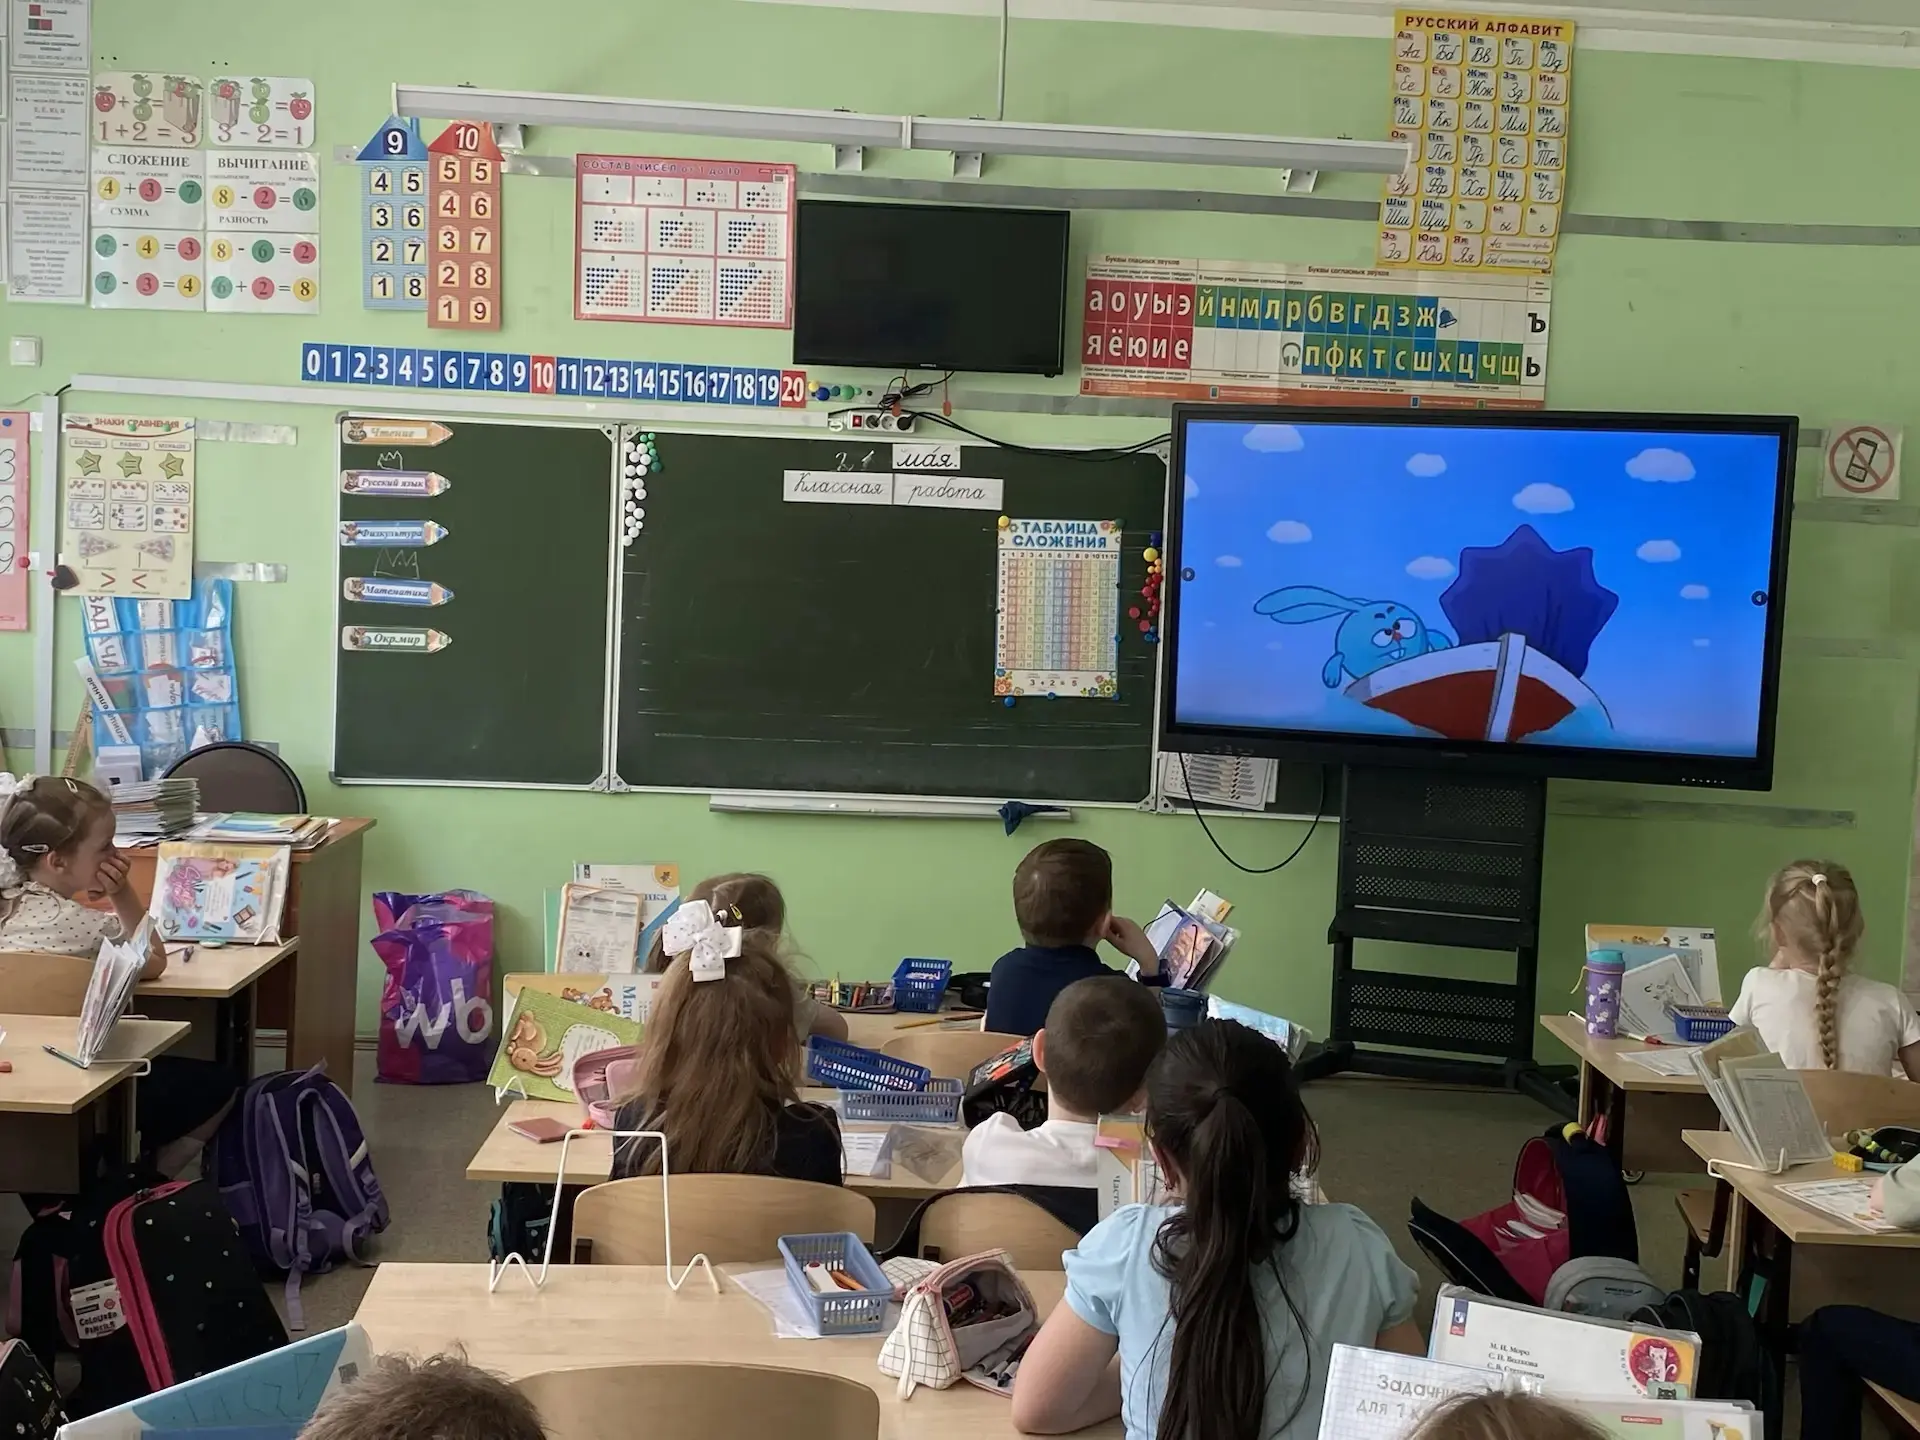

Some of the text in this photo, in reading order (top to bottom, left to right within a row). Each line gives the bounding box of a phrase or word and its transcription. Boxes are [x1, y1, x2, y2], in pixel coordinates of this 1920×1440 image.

[1406, 16, 1564, 37] РУССКИЙ АЛФАВИТ
[388, 131, 403, 154] 9
[456, 126, 479, 150] 10
[108, 154, 190, 168] СЛОЖЕНИЕ
[218, 157, 310, 171] ВЫЧИТАНИЕ
[583, 160, 631, 171] СОСТАВ
[636, 162, 677, 172] ЧИСЕЛ
[444, 161, 488, 181] 5 5
[104, 180, 195, 198] 4 3 7
[375, 173, 419, 192] 4 5
[219, 189, 308, 206] 8 2 6
[442, 196, 487, 216] 4 6
[110, 207, 150, 217] СУММА
[219, 216, 269, 225] РАЗНОСТЬ
[376, 208, 420, 227] 3 6
[443, 231, 487, 250] 3 7
[376, 243, 421, 262] 2 7
[1105, 255, 1125, 264] Буквы
[442, 266, 487, 286] 2 8
[1308, 266, 1326, 276] Буквы
[378, 278, 421, 297] 1 8
[443, 301, 486, 320] 1 9
[1089, 290, 1192, 321] а о у ы э
[1198, 288, 1435, 331] й н м л р б в г д з ж
[1087, 327, 1190, 361] я ё ю и е
[1305, 340, 1520, 382] п ф к т с ш х ц ч щ
[307, 350, 804, 402] 0 1 2 3 4 5 6 7 8 9 10 11 12 13 14 15 16 17 18 19 20
[94, 418, 124, 426] ЗНАКИ
[127, 420, 179, 428] СРАВНЕНИЯ
[370, 428, 414, 438] Чтение
[361, 478, 424, 488] Русский язык
[794, 472, 986, 504] Классная работа
[360, 528, 422, 539] Физкультура
[1021, 522, 1098, 536] ТАБЛИЦА
[1012, 535, 1107, 548] СЛОЖЕНИЯ
[365, 586, 428, 598] Математика
[1356, 1400, 1388, 1416] для
